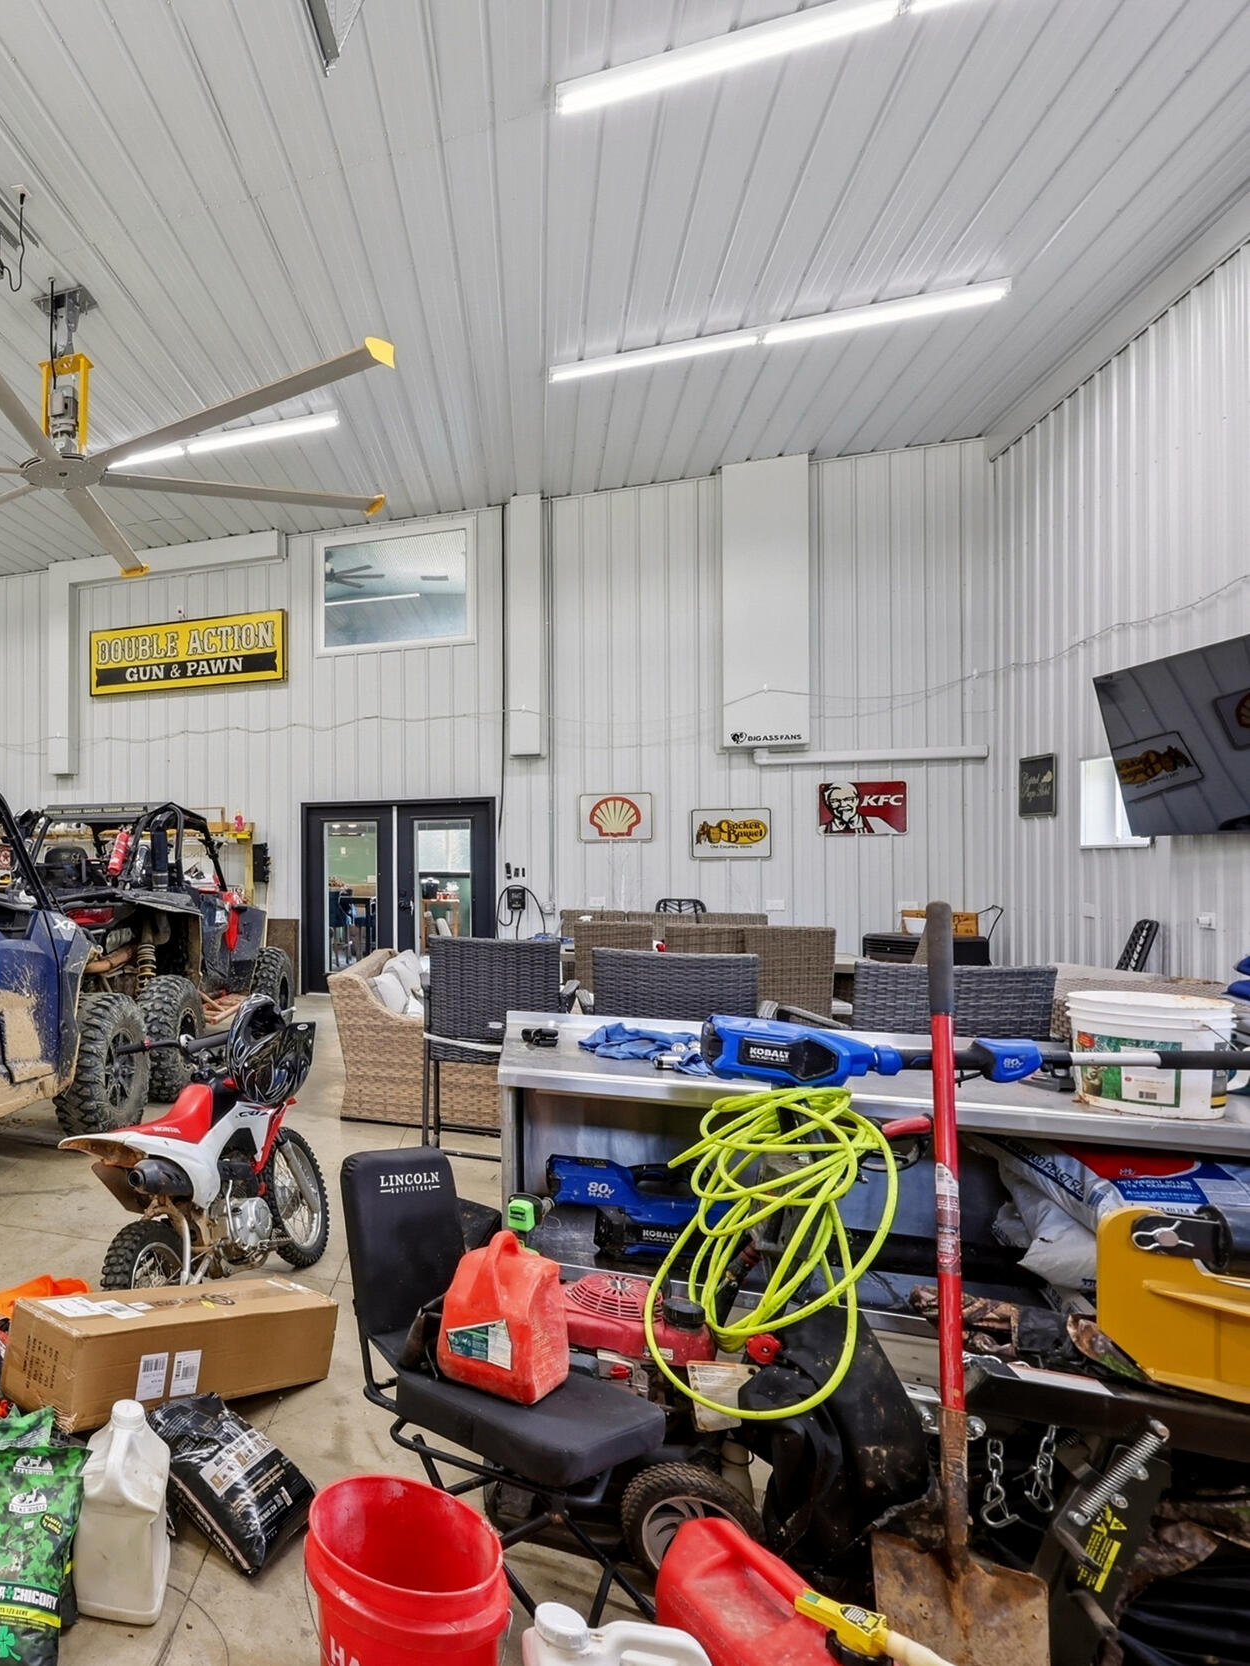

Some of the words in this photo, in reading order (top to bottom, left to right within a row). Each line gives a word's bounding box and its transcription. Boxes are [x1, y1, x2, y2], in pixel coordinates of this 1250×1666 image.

[96, 631, 180, 665] DOUBLE
[187, 620, 275, 656] ACTION
[125, 664, 165, 682] GUN
[170, 664, 181, 678] &
[186, 657, 244, 677] PAWN
[860, 795, 904, 806] KFC
[749, 1046, 790, 1059] KOBALT
[379, 1171, 441, 1187] LINCOLN
[588, 1191, 610, 1199] MAX
[642, 1229, 679, 1240] KOBALT
[12, 1586, 59, 1610] CHICORY
